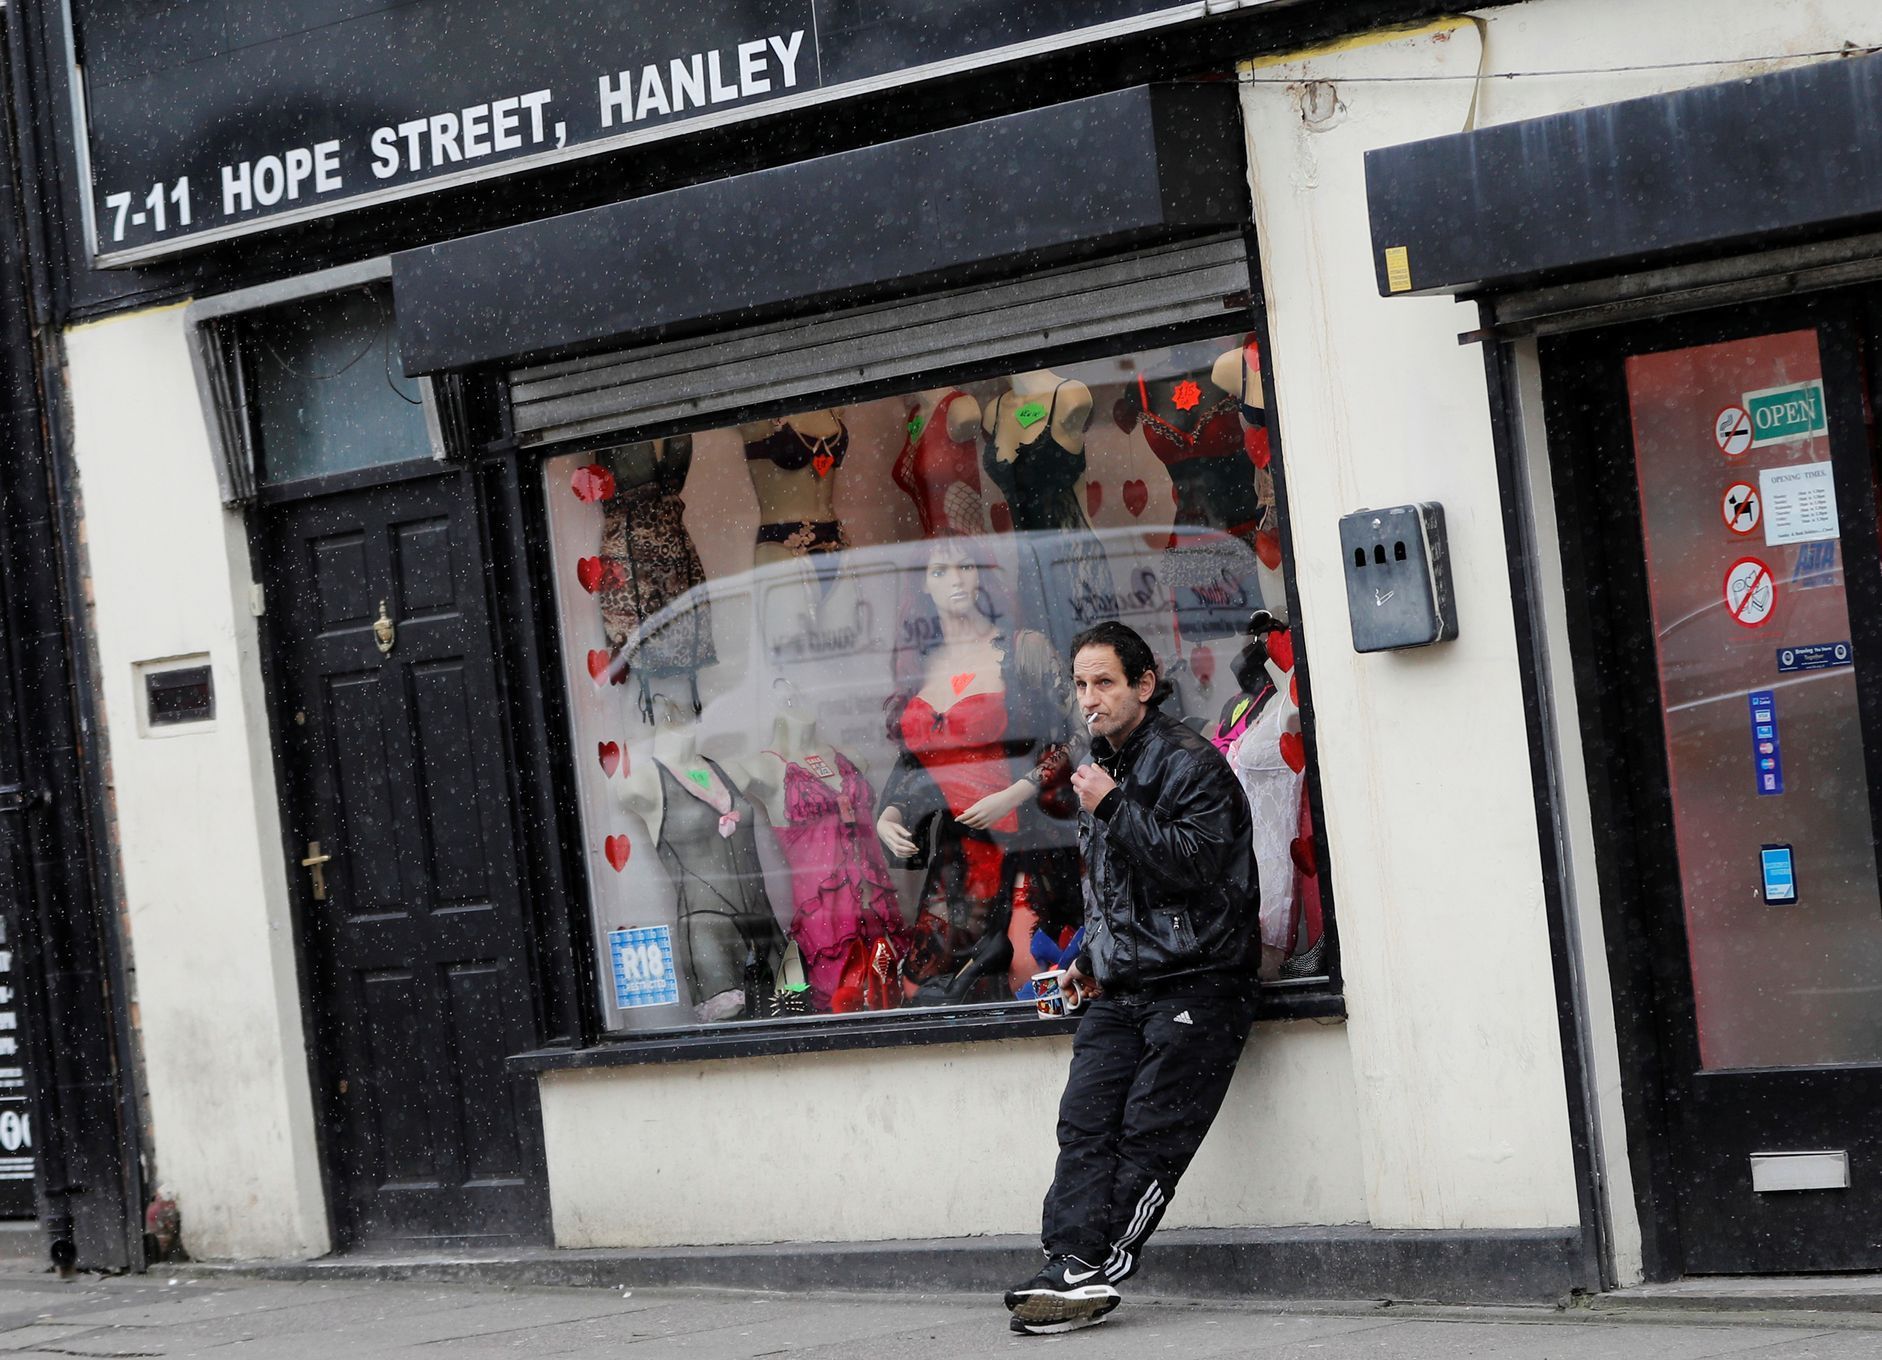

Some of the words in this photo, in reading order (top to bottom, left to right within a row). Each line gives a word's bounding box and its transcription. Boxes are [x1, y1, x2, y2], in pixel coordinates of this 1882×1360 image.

[106, 177, 191, 242] 7-11
[222, 140, 343, 215] HOPE
[371, 89, 568, 179] STREET,
[598, 29, 805, 128] HANLEY
[1756, 398, 1816, 429] OPEN
[619, 943, 665, 981] R18
